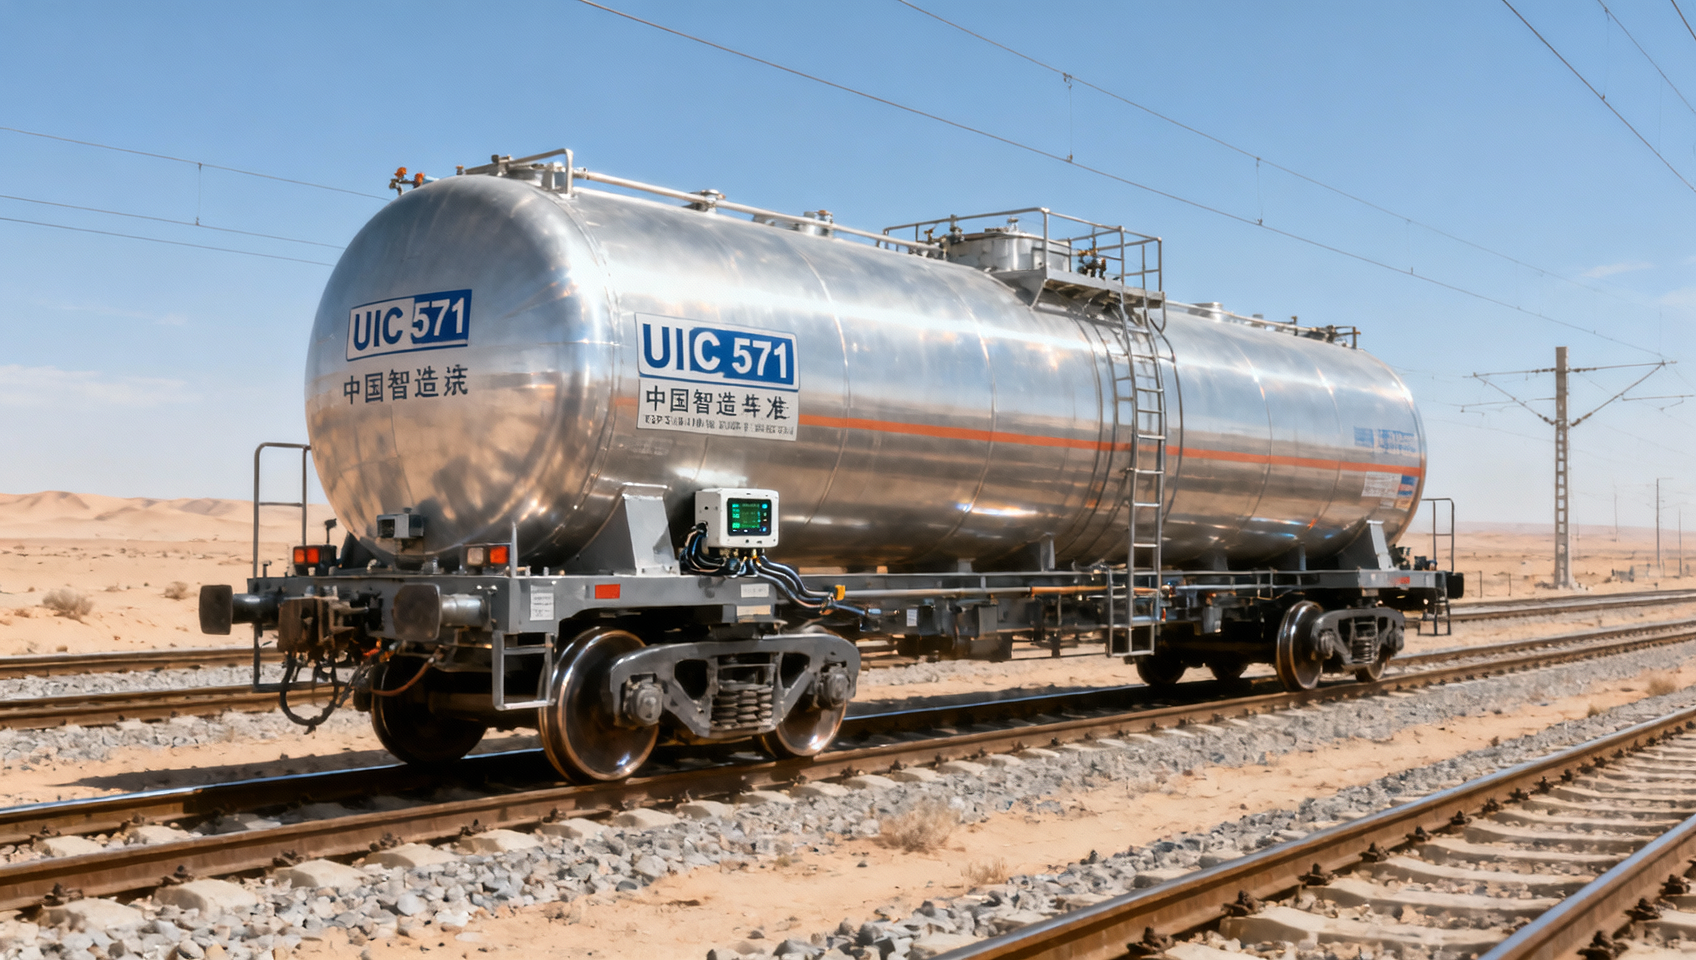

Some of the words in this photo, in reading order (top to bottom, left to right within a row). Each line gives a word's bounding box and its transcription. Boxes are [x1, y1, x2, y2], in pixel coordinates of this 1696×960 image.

[353, 306, 404, 351] UIC
[410, 297, 465, 339] 571
[642, 323, 721, 371] UIC
[731, 337, 787, 379] 571
